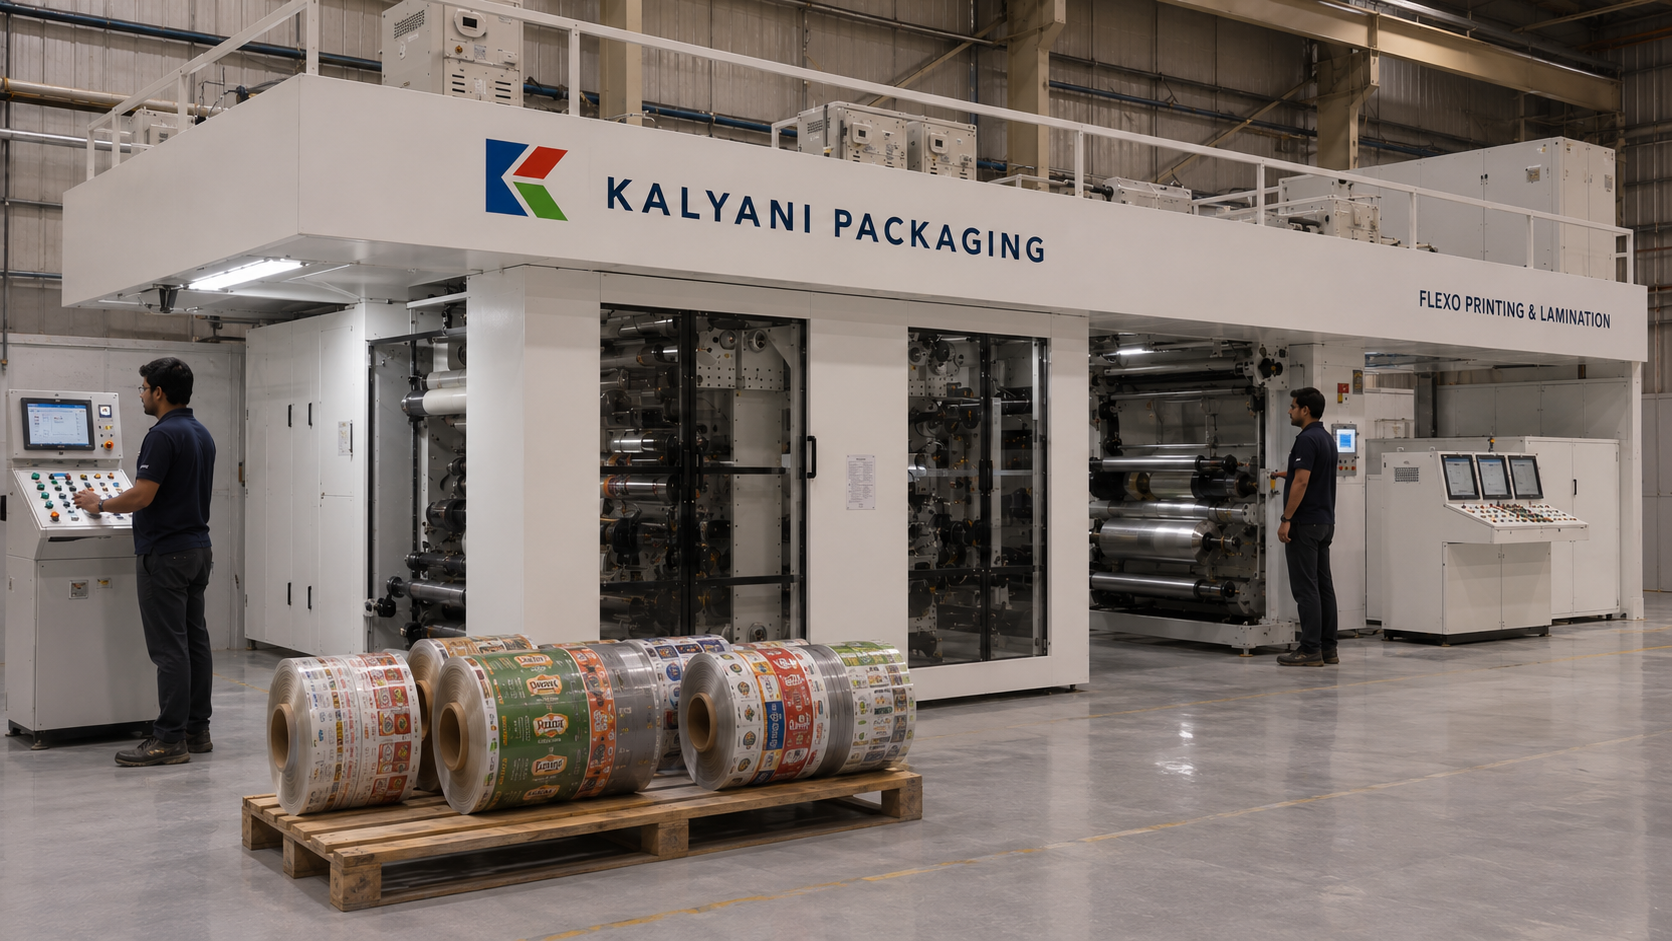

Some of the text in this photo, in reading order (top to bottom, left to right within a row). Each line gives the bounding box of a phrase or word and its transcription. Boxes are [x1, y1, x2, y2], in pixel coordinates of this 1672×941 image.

[607, 176, 1045, 263] KALYANI PACKAGING
[1419, 289, 1611, 329] FLEXO PRINTING & LAMINATION
